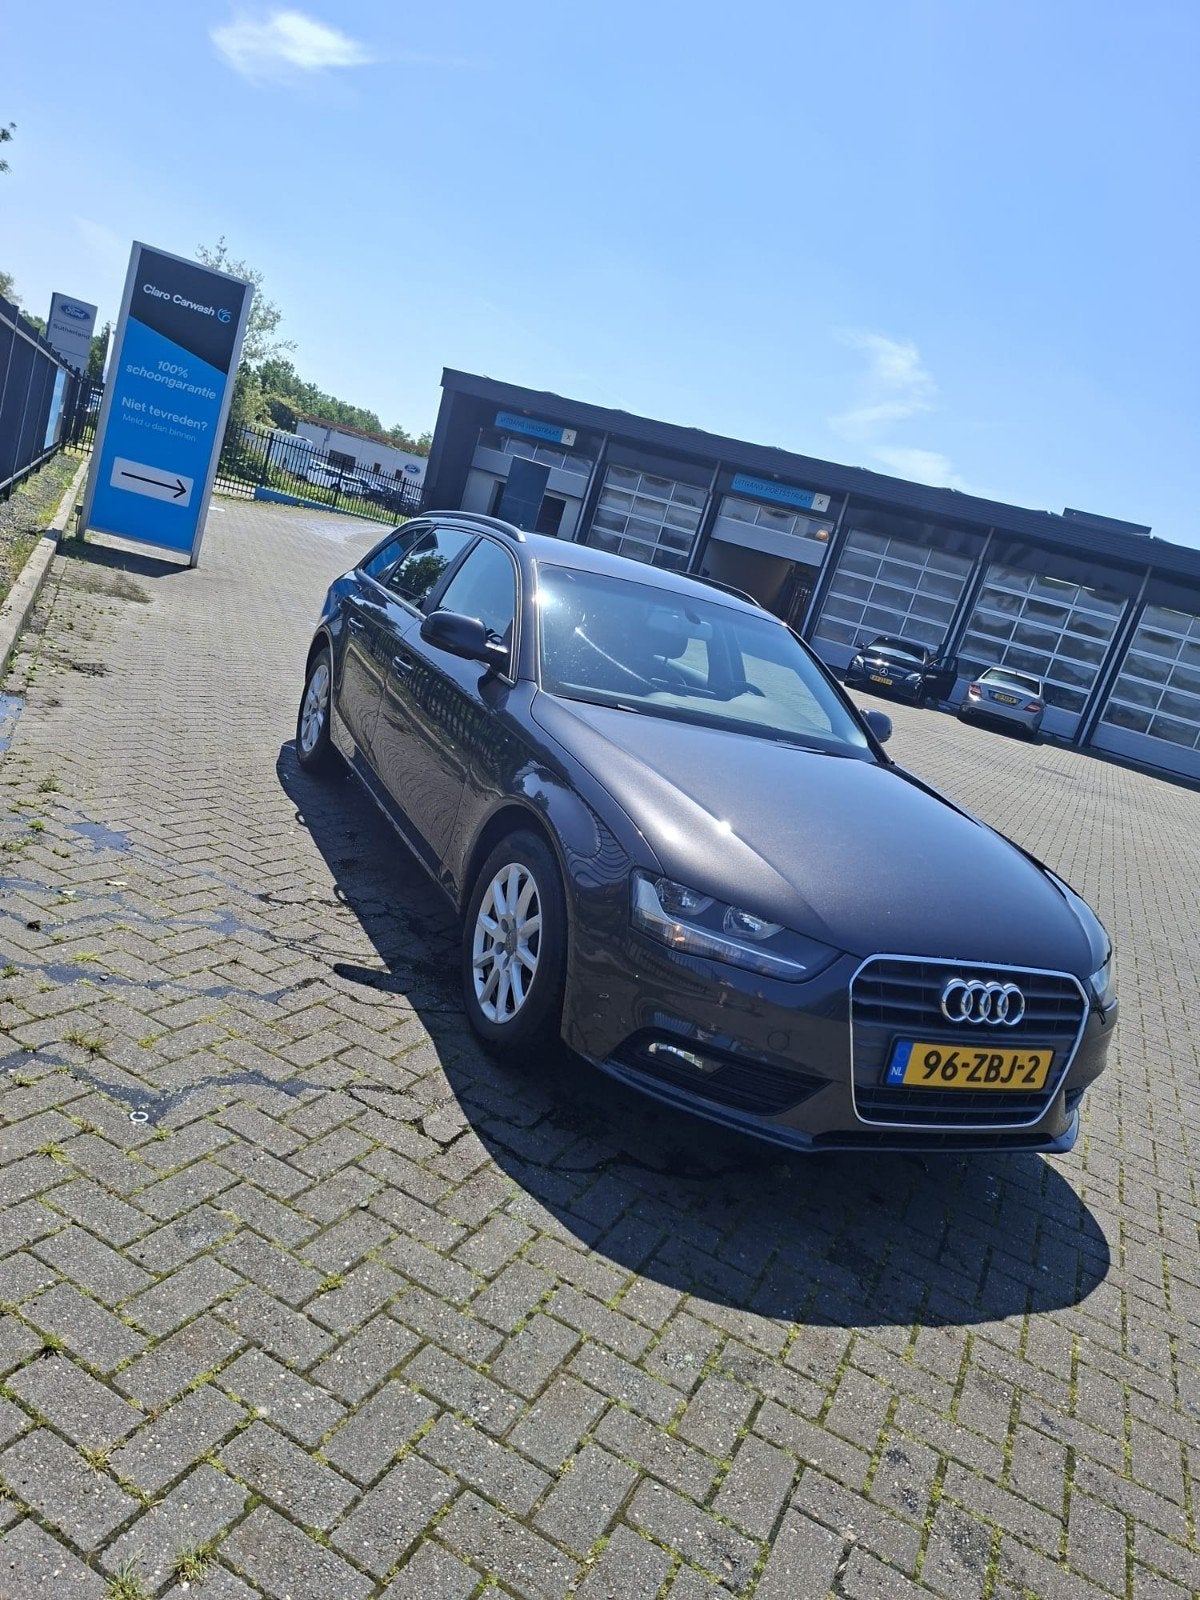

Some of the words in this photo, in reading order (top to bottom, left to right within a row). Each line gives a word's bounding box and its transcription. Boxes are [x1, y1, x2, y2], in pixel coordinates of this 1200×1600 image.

[65, 306, 86, 318] Ford
[143, 284, 170, 300] Claro
[172, 294, 215, 316] Carwash
[126, 364, 216, 400] schoongarantie
[158, 361, 188, 378] 100%
[122, 397, 146, 412] Niet
[149, 405, 208, 432] tevreden?
[122, 414, 144, 426] Meld
[152, 422, 168, 434] dan
[169, 428, 196, 442] binnen
[891, 1066, 902, 1076] NL
[922, 1050, 1041, 1084] 96-ZBJ-2
